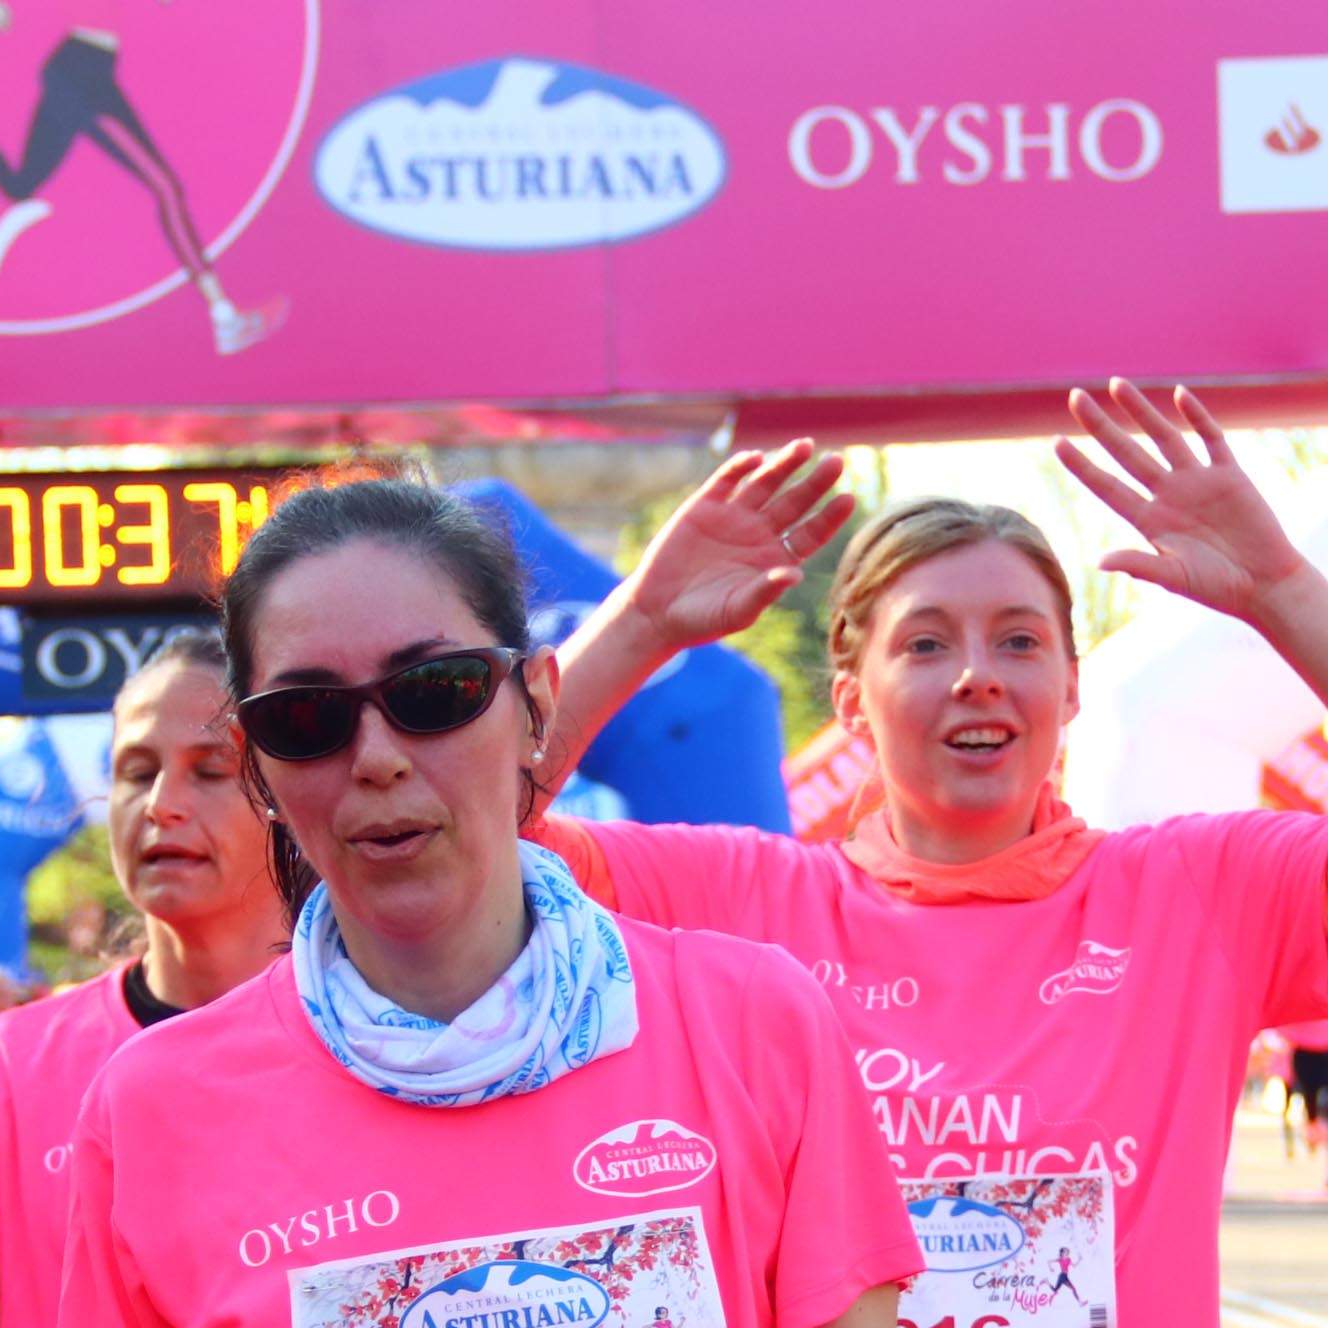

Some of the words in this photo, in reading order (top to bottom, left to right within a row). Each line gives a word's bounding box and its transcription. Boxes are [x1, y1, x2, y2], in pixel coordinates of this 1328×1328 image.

[787, 98, 1162, 189] OYSHO
[348, 135, 695, 203] ASTURIANA
[872, 1093, 1024, 1147] ANAN
[587, 1151, 709, 1184] ASTURIANA
[238, 1190, 400, 1268] OYSHO
[444, 1295, 510, 1313] CENTRAL
[516, 1285, 584, 1301] LECHERA
[973, 1271, 1036, 1290] Carrera
[1010, 1283, 1059, 1315] Mujer
